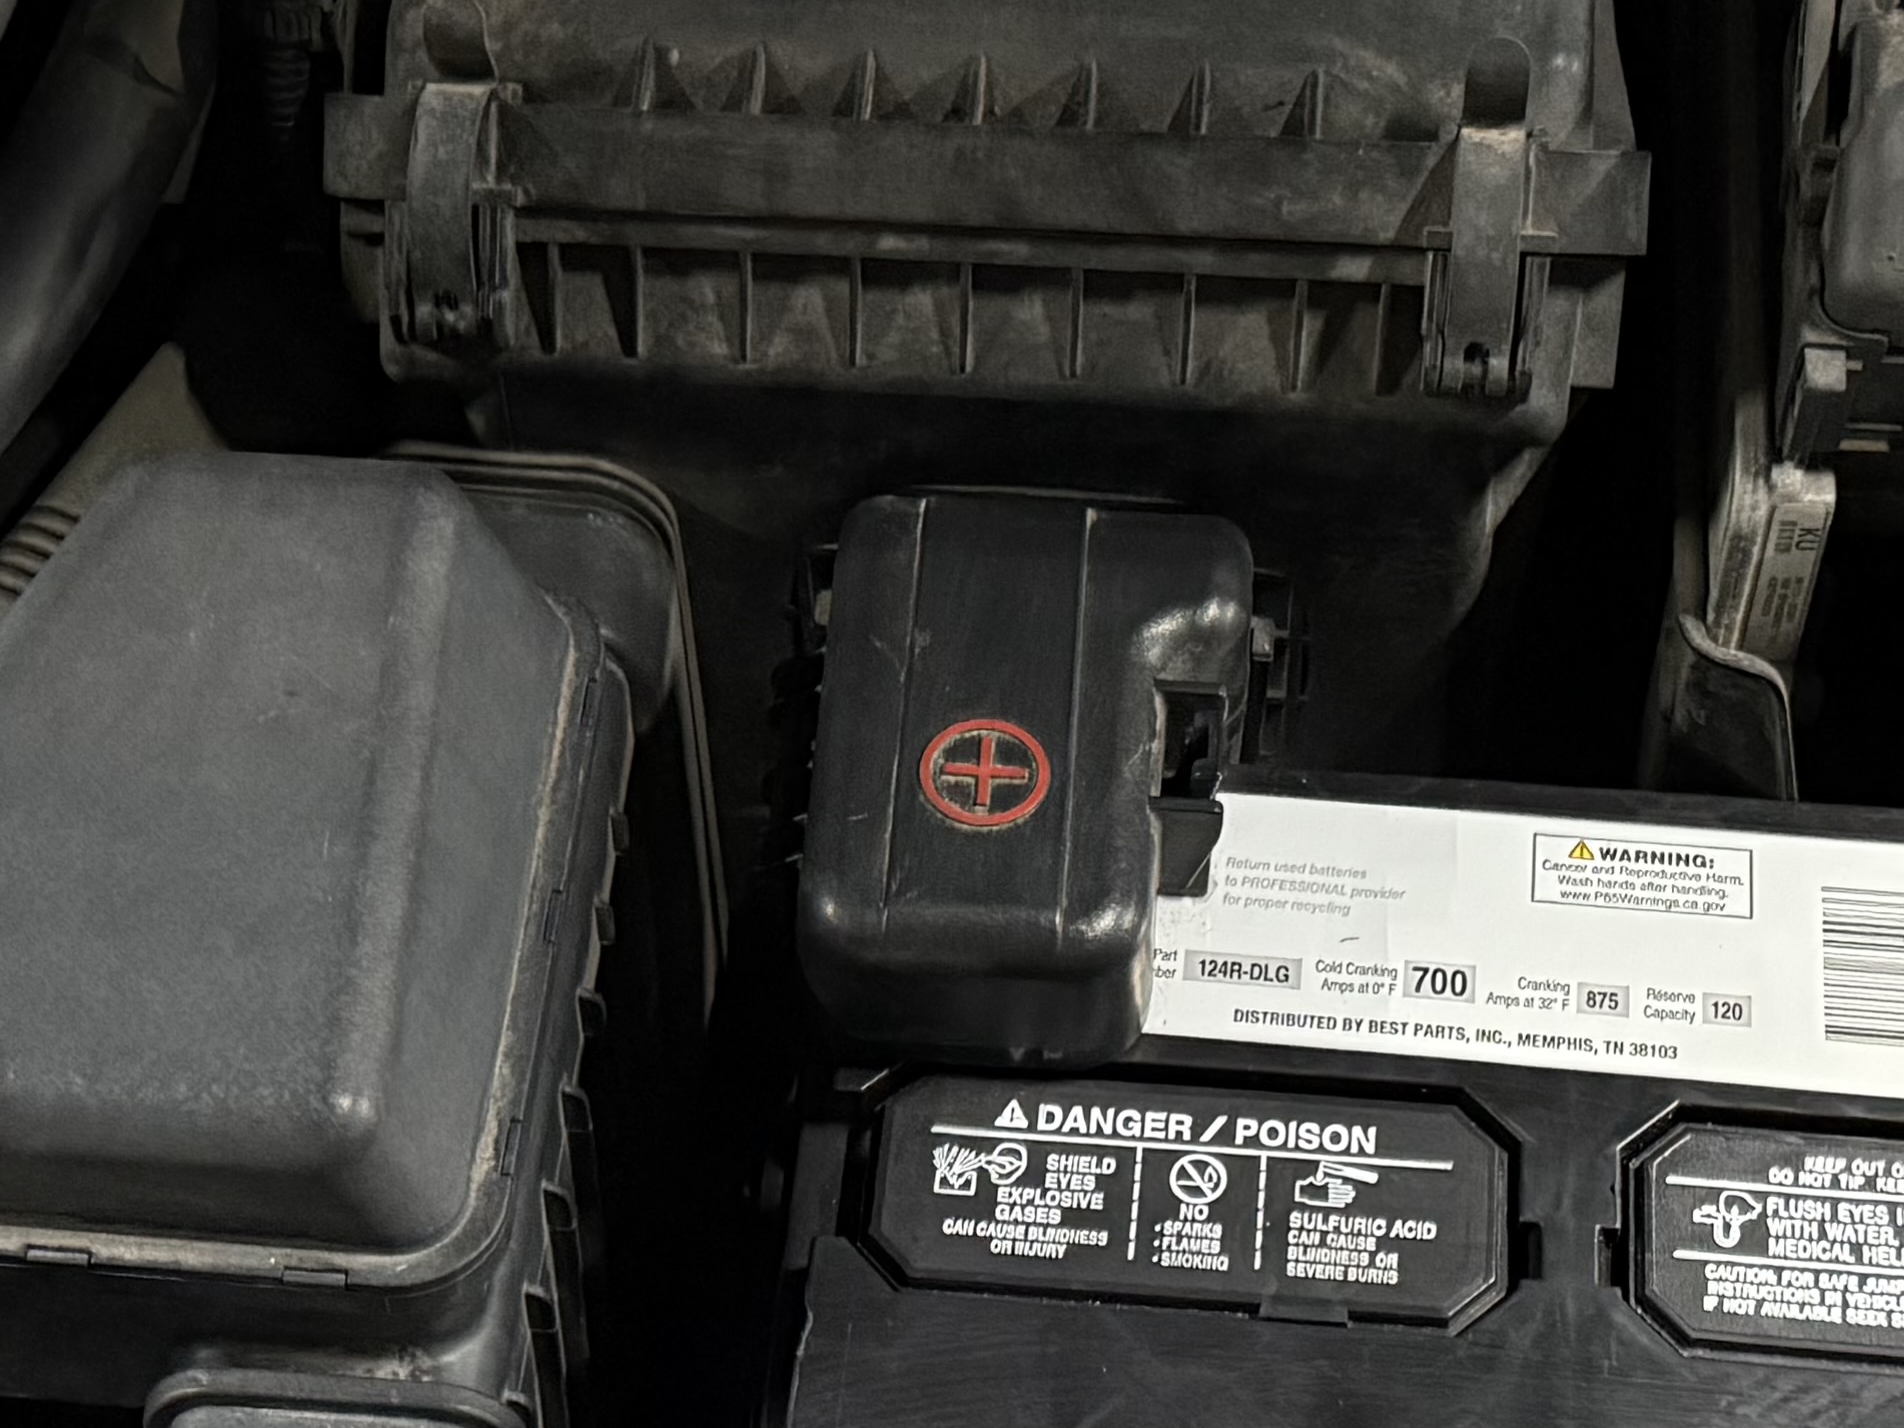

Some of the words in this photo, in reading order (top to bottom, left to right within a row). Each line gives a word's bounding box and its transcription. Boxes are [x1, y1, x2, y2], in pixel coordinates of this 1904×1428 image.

[1225, 856, 1271, 872] Return
[1273, 862, 1307, 875] used
[1308, 862, 1368, 880] batteries
[1598, 847, 1715, 869] WARNING:
[1557, 874, 1594, 887] Wash
[1597, 877, 1636, 891] hands
[1639, 881, 1668, 893] after
[1591, 865, 1615, 876] and
[1619, 865, 1702, 883] Reproductive
[1224, 873, 1238, 887] to
[1240, 875, 1347, 897] PROFESSIONAL
[1350, 886, 1407, 900] provider
[1222, 892, 1241, 906] for
[1242, 896, 1290, 911] proper
[1290, 900, 1352, 918] recycling
[1152, 947, 1178, 962] Part
[1198, 959, 1290, 984] 124R-DLG
[1314, 958, 1343, 975] Cold
[1345, 961, 1398, 982] Cranking
[1411, 965, 1468, 997] 700
[1320, 977, 1355, 995] Amps
[1357, 981, 1370, 994] at
[1387, 983, 1397, 996] F
[1517, 976, 1571, 997] Cranking
[1646, 987, 1696, 1005] Reserve
[1485, 991, 1521, 1010] Amps
[1522, 996, 1535, 1009] at
[1561, 998, 1570, 1012] F
[1585, 990, 1619, 1011] 875
[1711, 1000, 1743, 1022] 120
[1643, 1004, 1696, 1025] Capacity
[1233, 1008, 1338, 1030] DISTRIBUTED
[1342, 1017, 1364, 1033] BY
[1368, 1019, 1409, 1036] BEST
[1413, 1022, 1471, 1044] PARTS,
[1475, 1028, 1512, 1048] INC.,
[1517, 1032, 1598, 1056] MEMPHIS,
[1603, 1040, 1624, 1056] TN
[1628, 1042, 1678, 1060] 38103
[1036, 1103, 1193, 1141] DANGER
[1234, 1117, 1377, 1155] POISON
[1046, 1153, 1117, 1175] SHIELD
[1804, 1155, 1848, 1175] KEEP
[1850, 1157, 1886, 1178] OUT
[1044, 1172, 1096, 1192] EYES
[1767, 1165, 1795, 1186] DO
[1798, 1170, 1834, 1189] NOT
[996, 1186, 1105, 1210] EXPLOSIVE
[995, 1203, 1062, 1225] GASES
[1179, 1202, 1209, 1221] NO
[1766, 1195, 1832, 1222] FLUSH
[1837, 1201, 1890, 1227] EYES
[942, 1217, 975, 1236] CAN
[975, 1220, 1027, 1240] CAUSE
[1026, 1225, 1109, 1246] BLINDNESS
[1289, 1211, 1387, 1237] SULFURIC
[1389, 1219, 1438, 1240] ACID
[1766, 1216, 1819, 1241] WITH
[990, 1238, 1013, 1255] OR
[1014, 1240, 1067, 1259] INJURY
[1287, 1229, 1320, 1247] CAN
[1325, 1232, 1378, 1252] CAUSE
[1766, 1236, 1856, 1264] MEDICAL
[1286, 1245, 1371, 1267] BLINDNESS
[1375, 1251, 1399, 1270] OR
[1286, 1261, 1346, 1281] SEVERE
[1347, 1266, 1399, 1285] BURNS
[1779, 1269, 1816, 1291] FOR
[1816, 1272, 1860, 1294] SAFE
[1705, 1280, 1821, 1306] INSTRUCTIONS
[1823, 1290, 1843, 1308] IN
[1703, 1295, 1720, 1312] IF
[1722, 1297, 1757, 1316] NOT
[1760, 1300, 1843, 1324] AVAILABLE
[1845, 1306, 1890, 1328] SEEK
